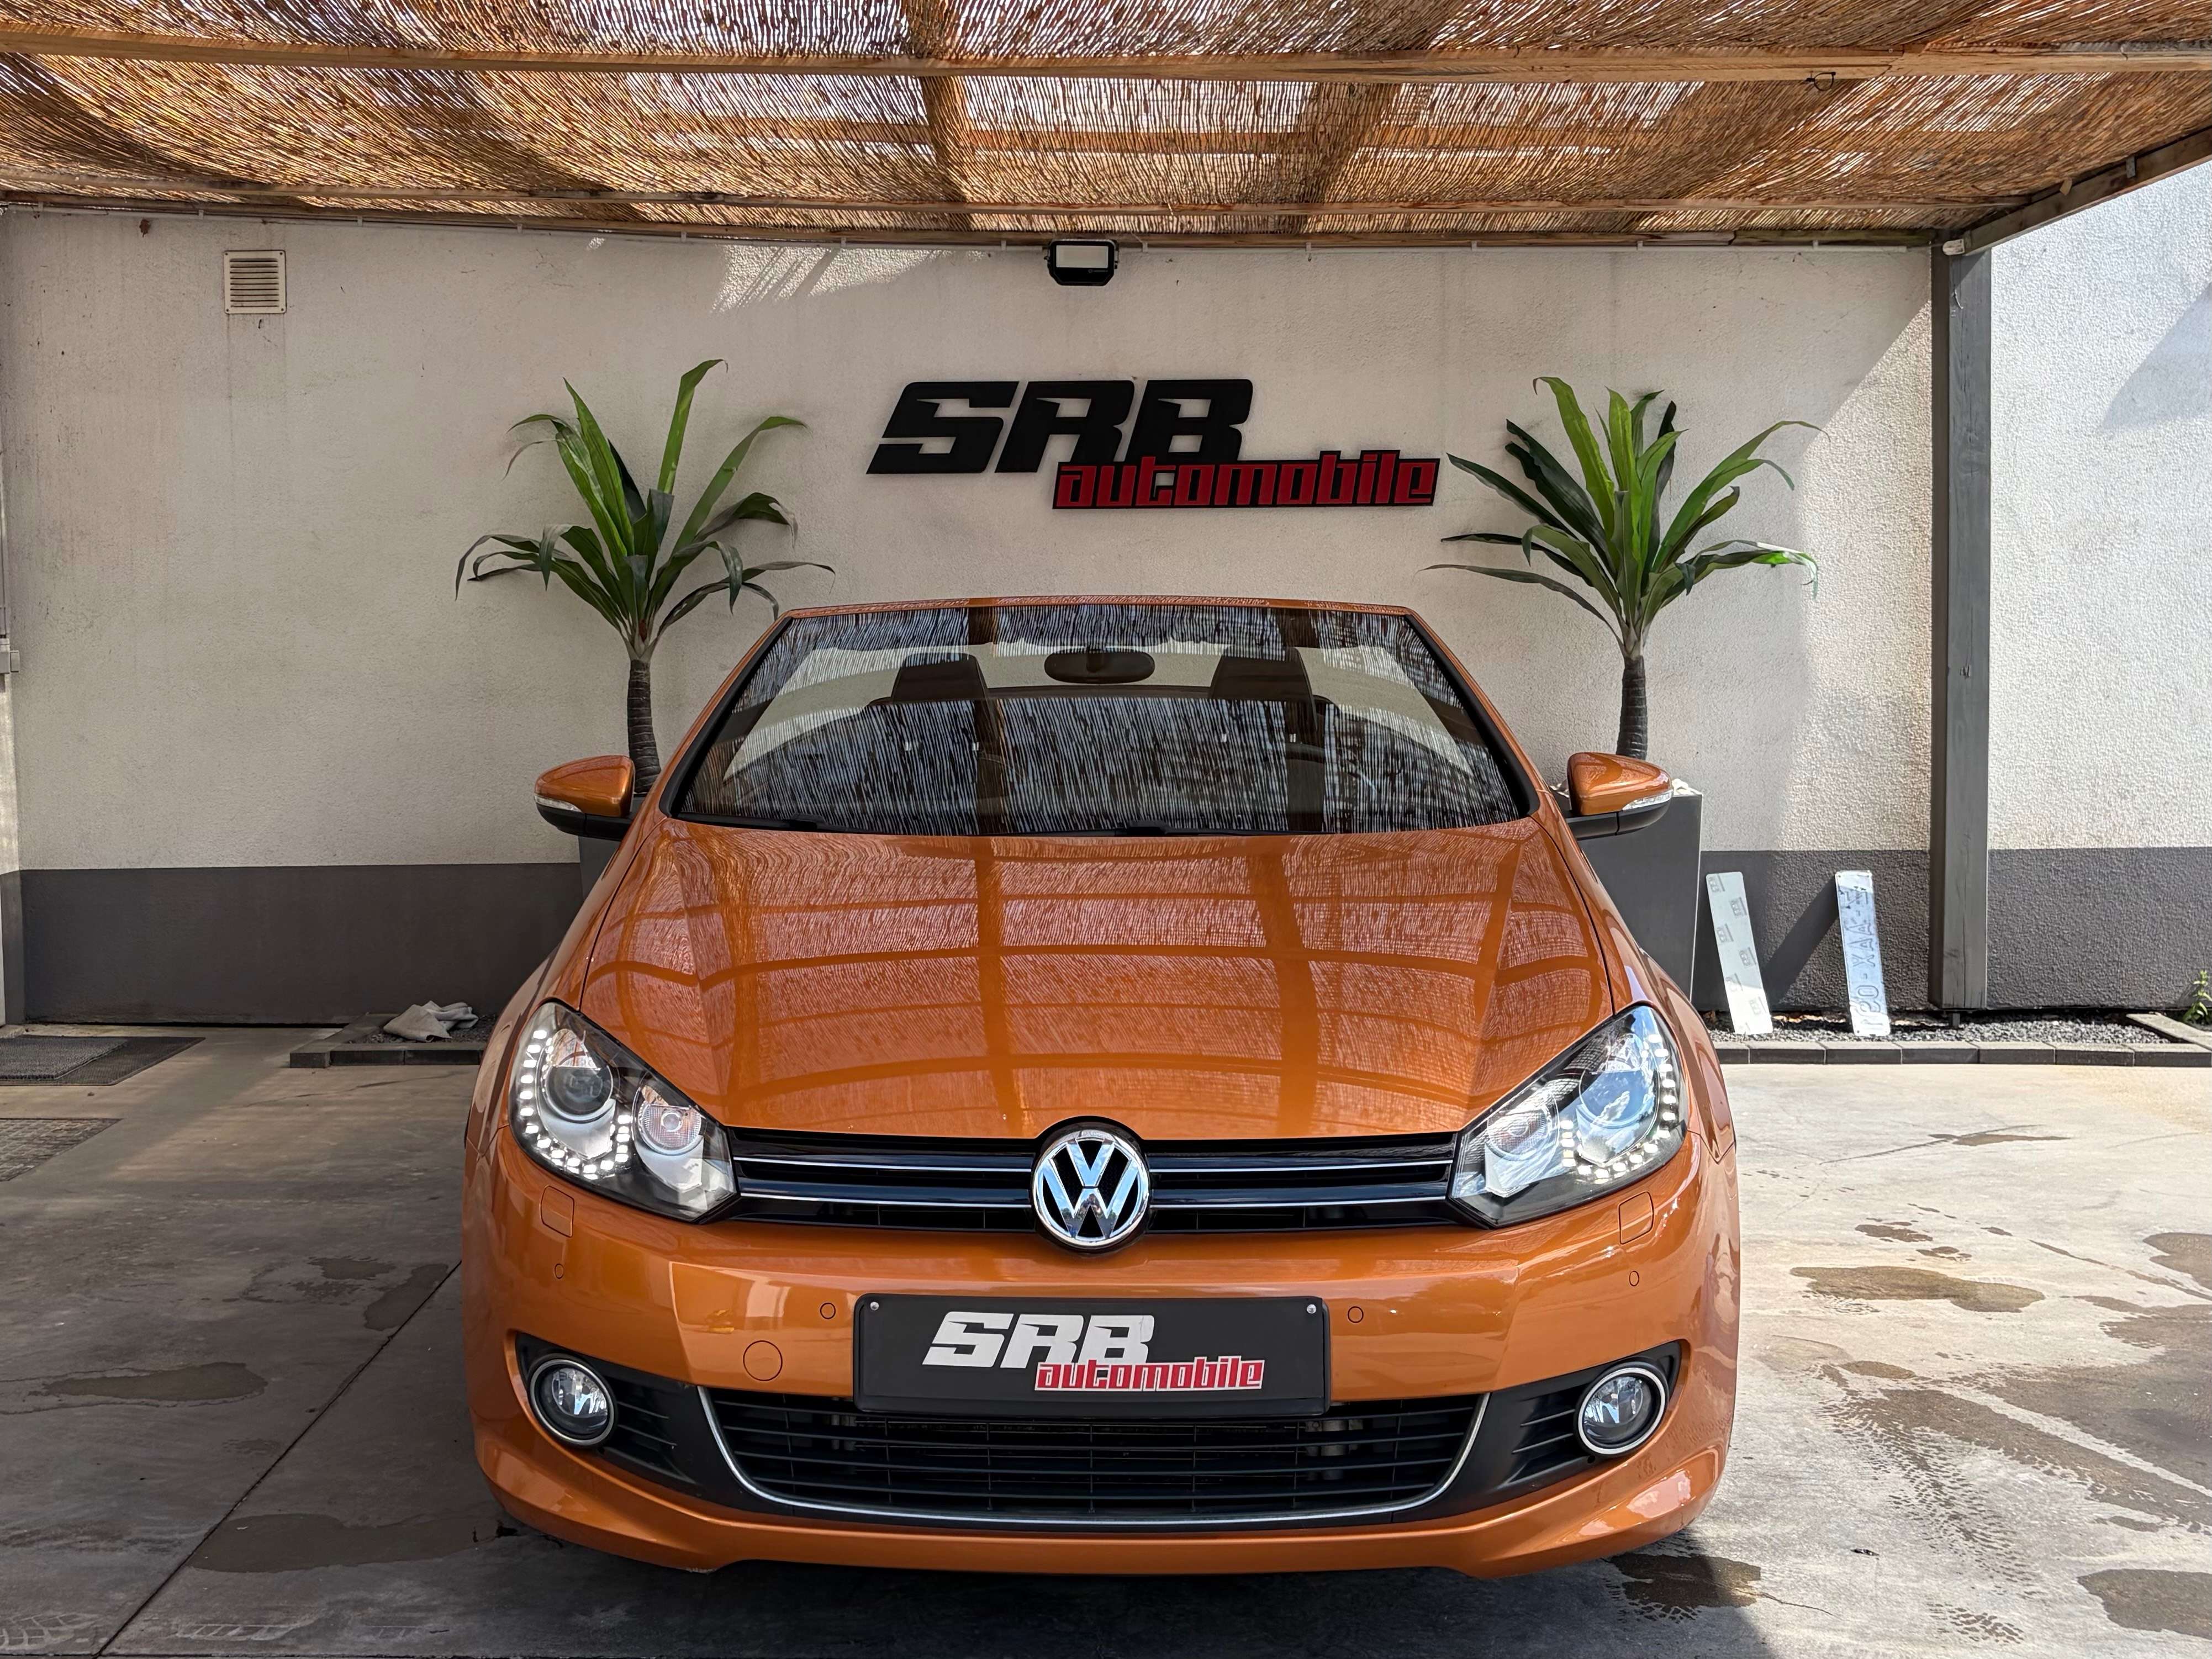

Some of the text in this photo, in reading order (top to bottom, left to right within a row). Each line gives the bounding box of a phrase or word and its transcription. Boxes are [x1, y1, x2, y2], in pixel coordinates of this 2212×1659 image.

[866, 379, 1253, 474] SRB
[1053, 450, 1440, 509] automobile
[1039, 1137, 1140, 1239] VW
[922, 1311, 1155, 1368] SRB
[1034, 1355, 1264, 1392] automobile
